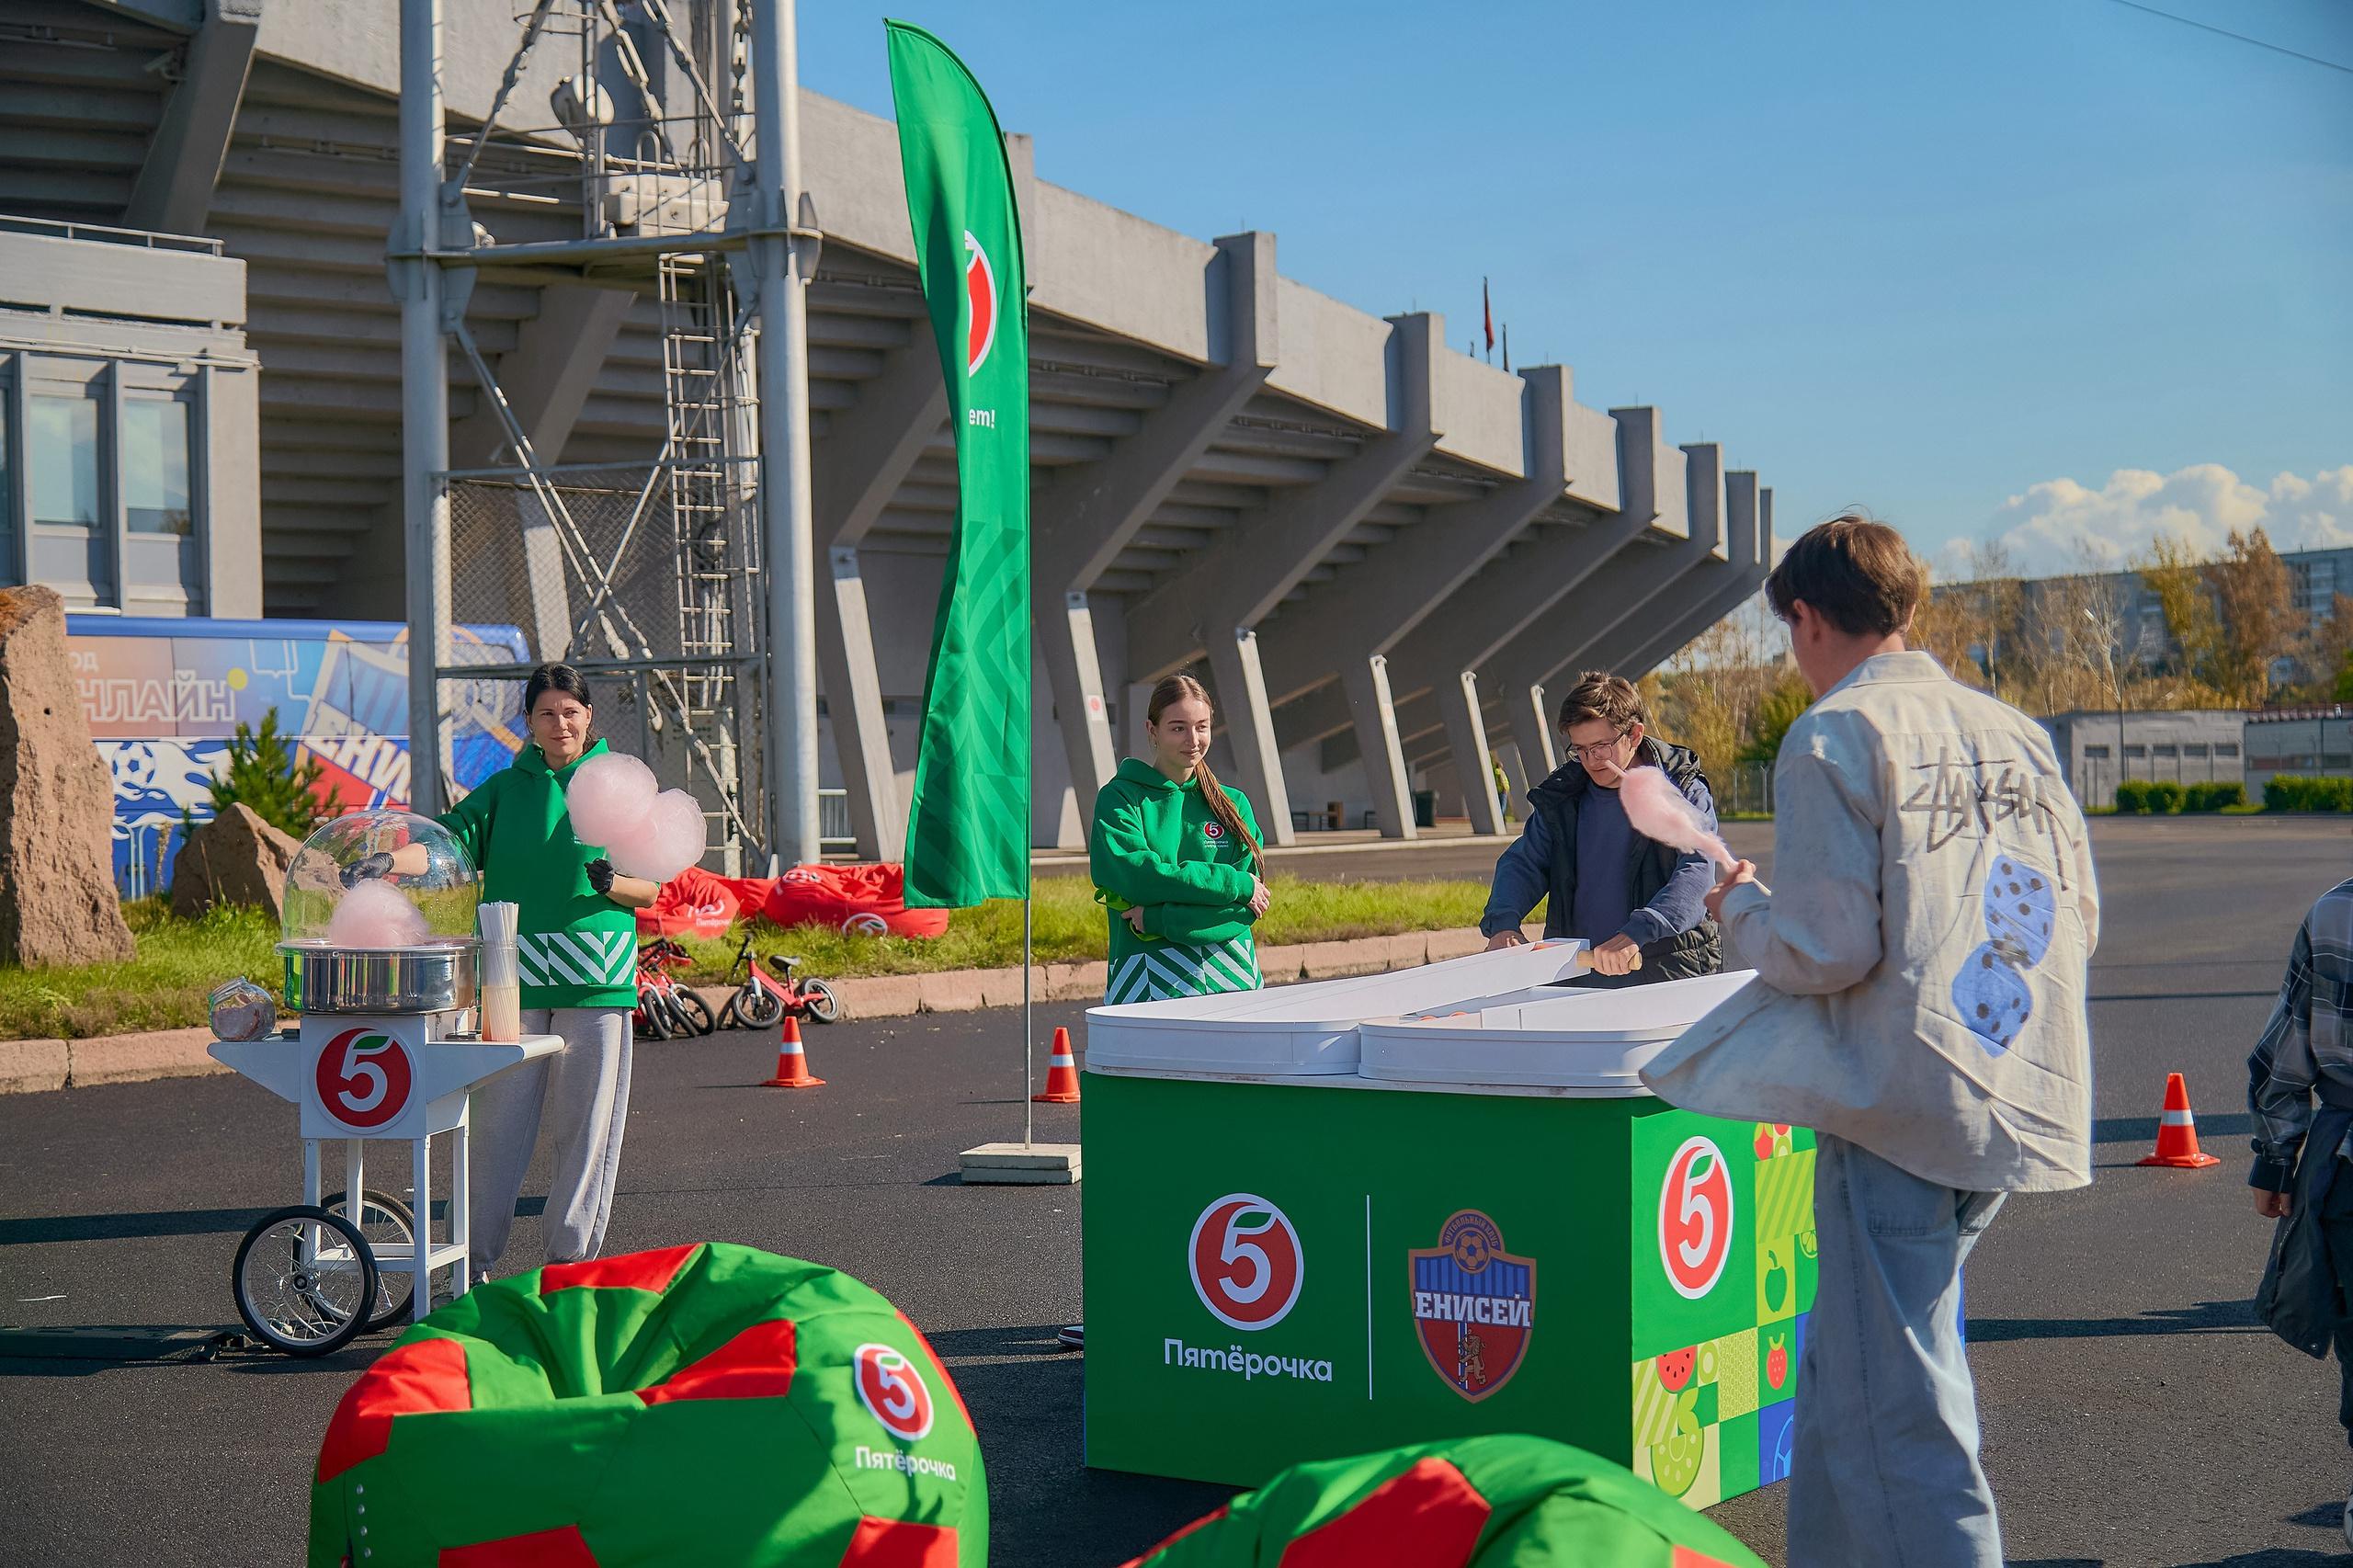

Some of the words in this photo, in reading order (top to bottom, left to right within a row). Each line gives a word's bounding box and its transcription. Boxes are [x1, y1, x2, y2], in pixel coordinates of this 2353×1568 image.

[969, 408, 995, 429] ет!
[75, 669, 236, 722] НЛАЙН
[303, 699, 412, 803] ЕНИ
[337, 1028, 392, 1112] 5
[1678, 1148, 1717, 1267] 5
[1218, 1204, 1277, 1304] 5
[1415, 1291, 1530, 1327] ЕНИСЕЙ
[875, 1353, 915, 1419] 5
[1164, 1337, 1333, 1382] Пятёрочка
[855, 1446, 957, 1481] Пятёрочка
